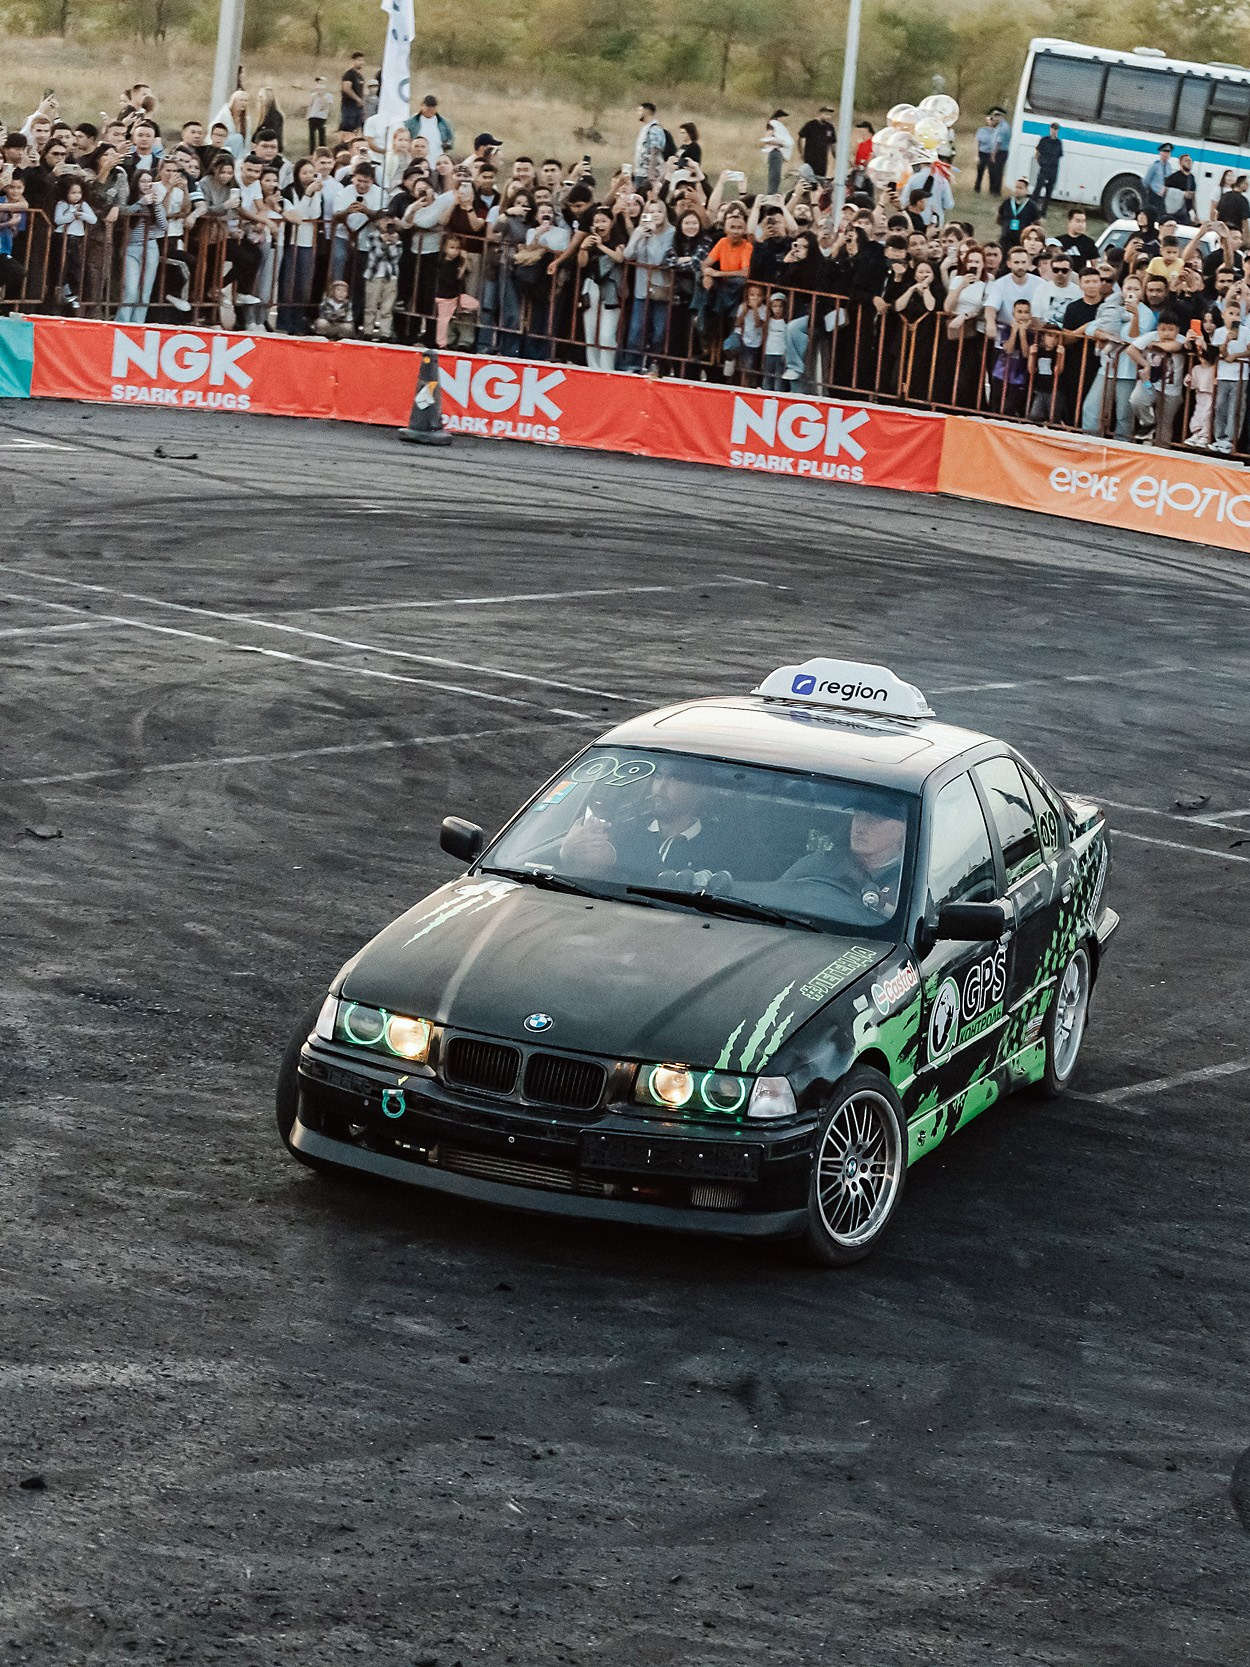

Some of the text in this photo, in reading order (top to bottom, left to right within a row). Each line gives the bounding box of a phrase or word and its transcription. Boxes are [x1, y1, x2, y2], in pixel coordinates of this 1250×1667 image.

[111, 328, 256, 389] NGK
[111, 384, 251, 409] SPARK PLUGS
[491, 418, 561, 441] PLUGS
[730, 395, 871, 461] NGK
[729, 449, 864, 481] SPARK PLUGS
[818, 680, 888, 702] region
[571, 756, 656, 787] 09
[883, 959, 918, 1003] Castrol
[962, 948, 1007, 1021] GPS
